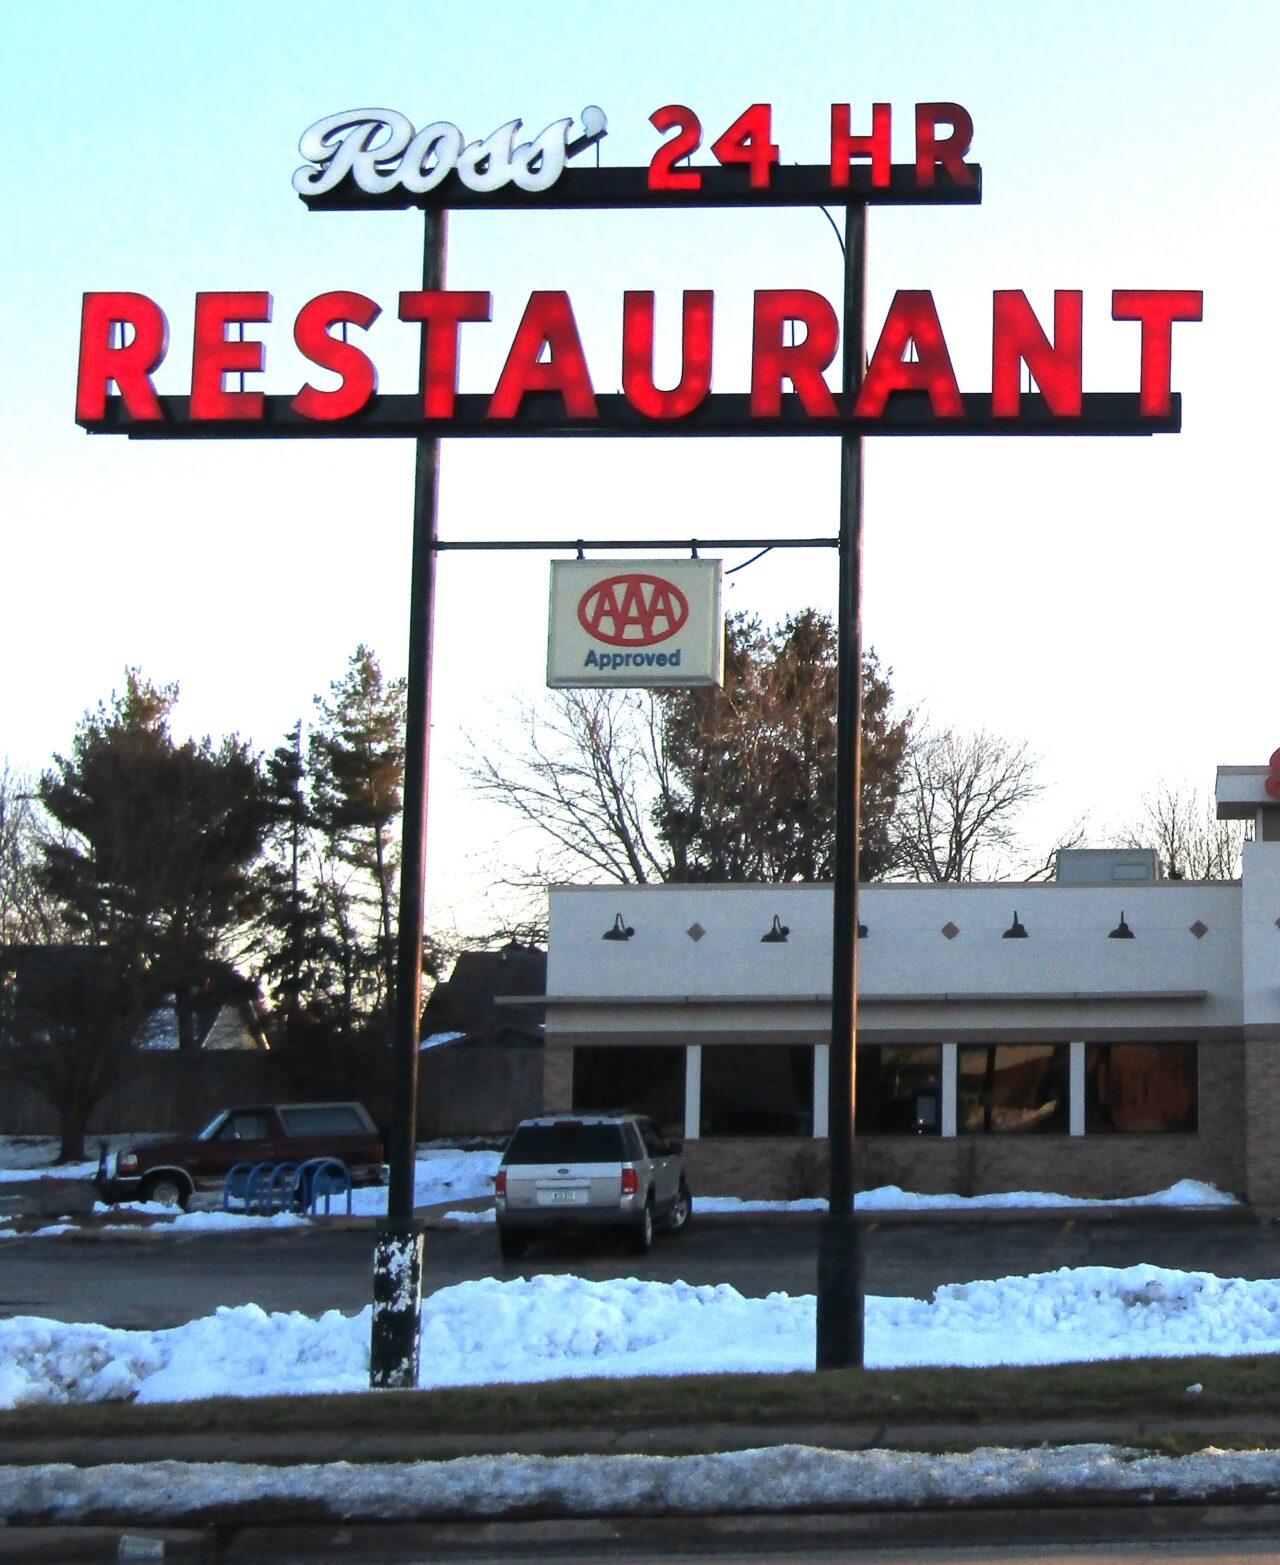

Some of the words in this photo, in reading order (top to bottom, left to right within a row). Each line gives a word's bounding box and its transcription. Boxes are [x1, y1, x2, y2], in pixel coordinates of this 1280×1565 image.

[291, 105, 608, 196] Ross'
[647, 104, 780, 190] 24
[831, 102, 977, 188] HR
[76, 289, 1203, 424] RESTAURANT
[590, 580, 674, 641] AAA
[584, 649, 681, 670] Approved
